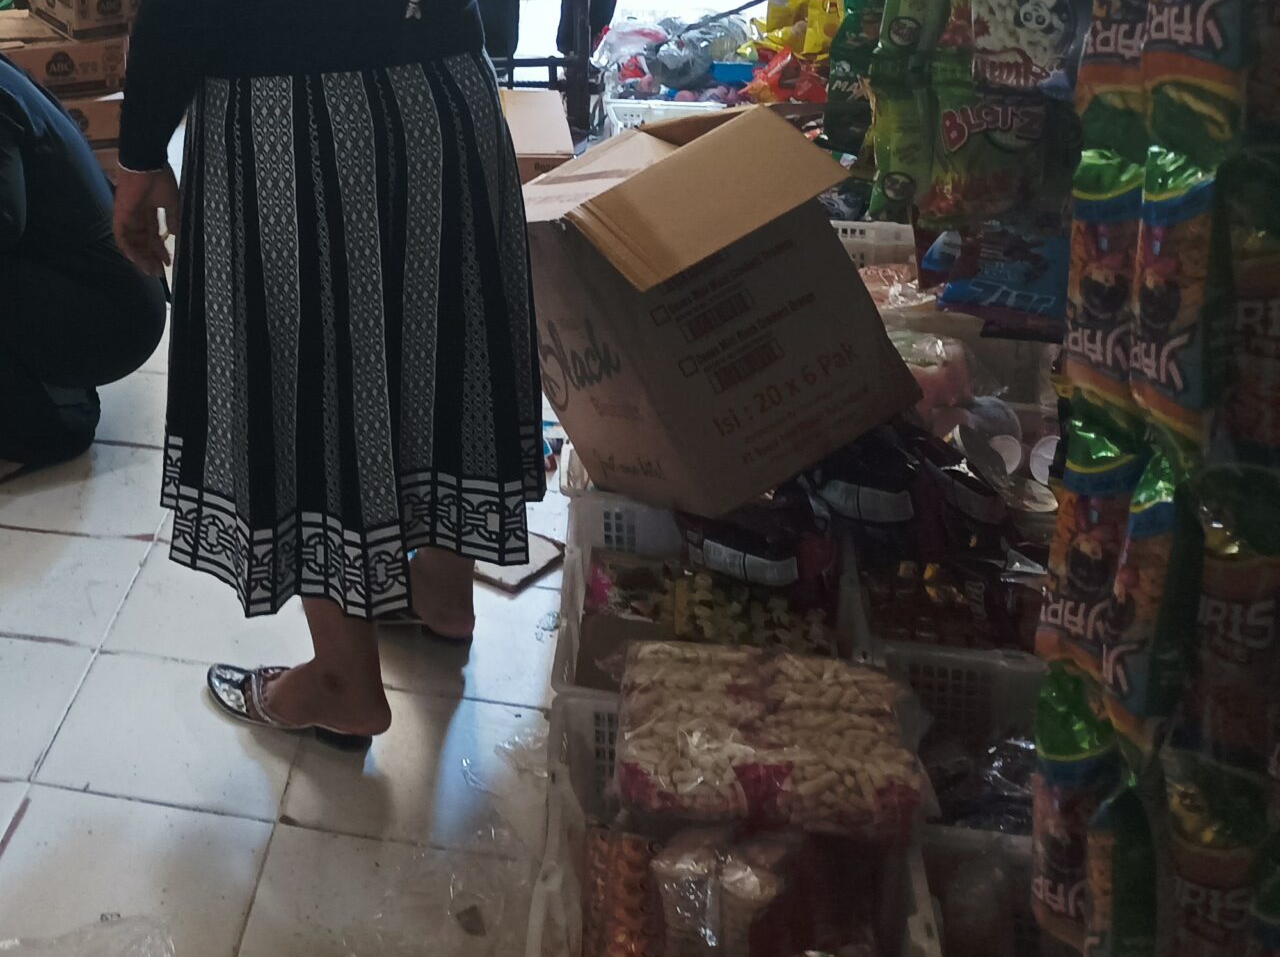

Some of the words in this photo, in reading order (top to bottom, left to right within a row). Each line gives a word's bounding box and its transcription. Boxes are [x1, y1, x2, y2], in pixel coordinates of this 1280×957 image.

[48, 62, 71, 73] ABC
[753, 383, 783, 414] 20
[784, 376, 801, 397] x
[800, 362, 818, 386] 6
[816, 341, 858, 376] Pak
